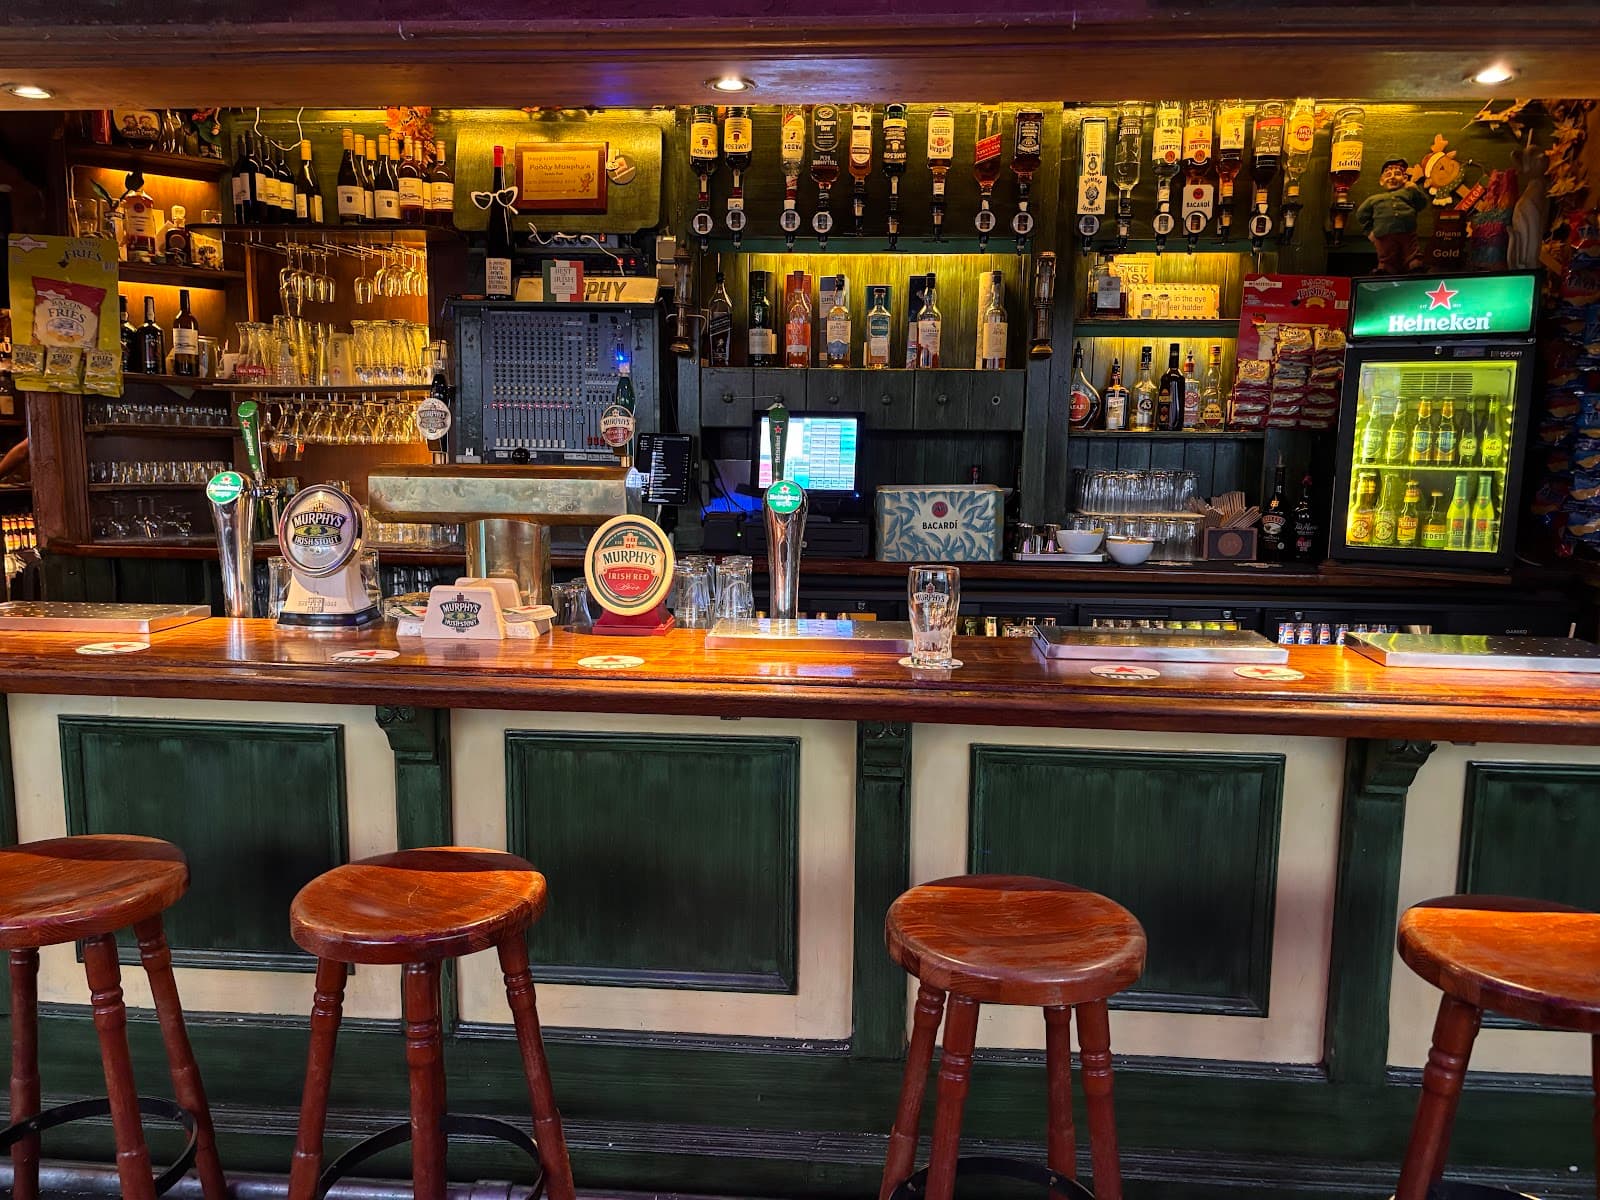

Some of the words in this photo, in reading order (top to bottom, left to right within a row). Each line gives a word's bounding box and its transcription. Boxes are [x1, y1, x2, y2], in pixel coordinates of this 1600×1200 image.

[1432, 248, 1460, 259] Gold
[584, 281, 627, 301] PHY
[47, 306, 87, 323] FRIES
[1388, 313, 1491, 332] Heineken
[922, 519, 958, 530] BACARDÍ
[294, 535, 314, 546] IRISH
[314, 535, 340, 547] STOUT
[608, 571, 632, 580] IRISH
[633, 572, 650, 581] RED
